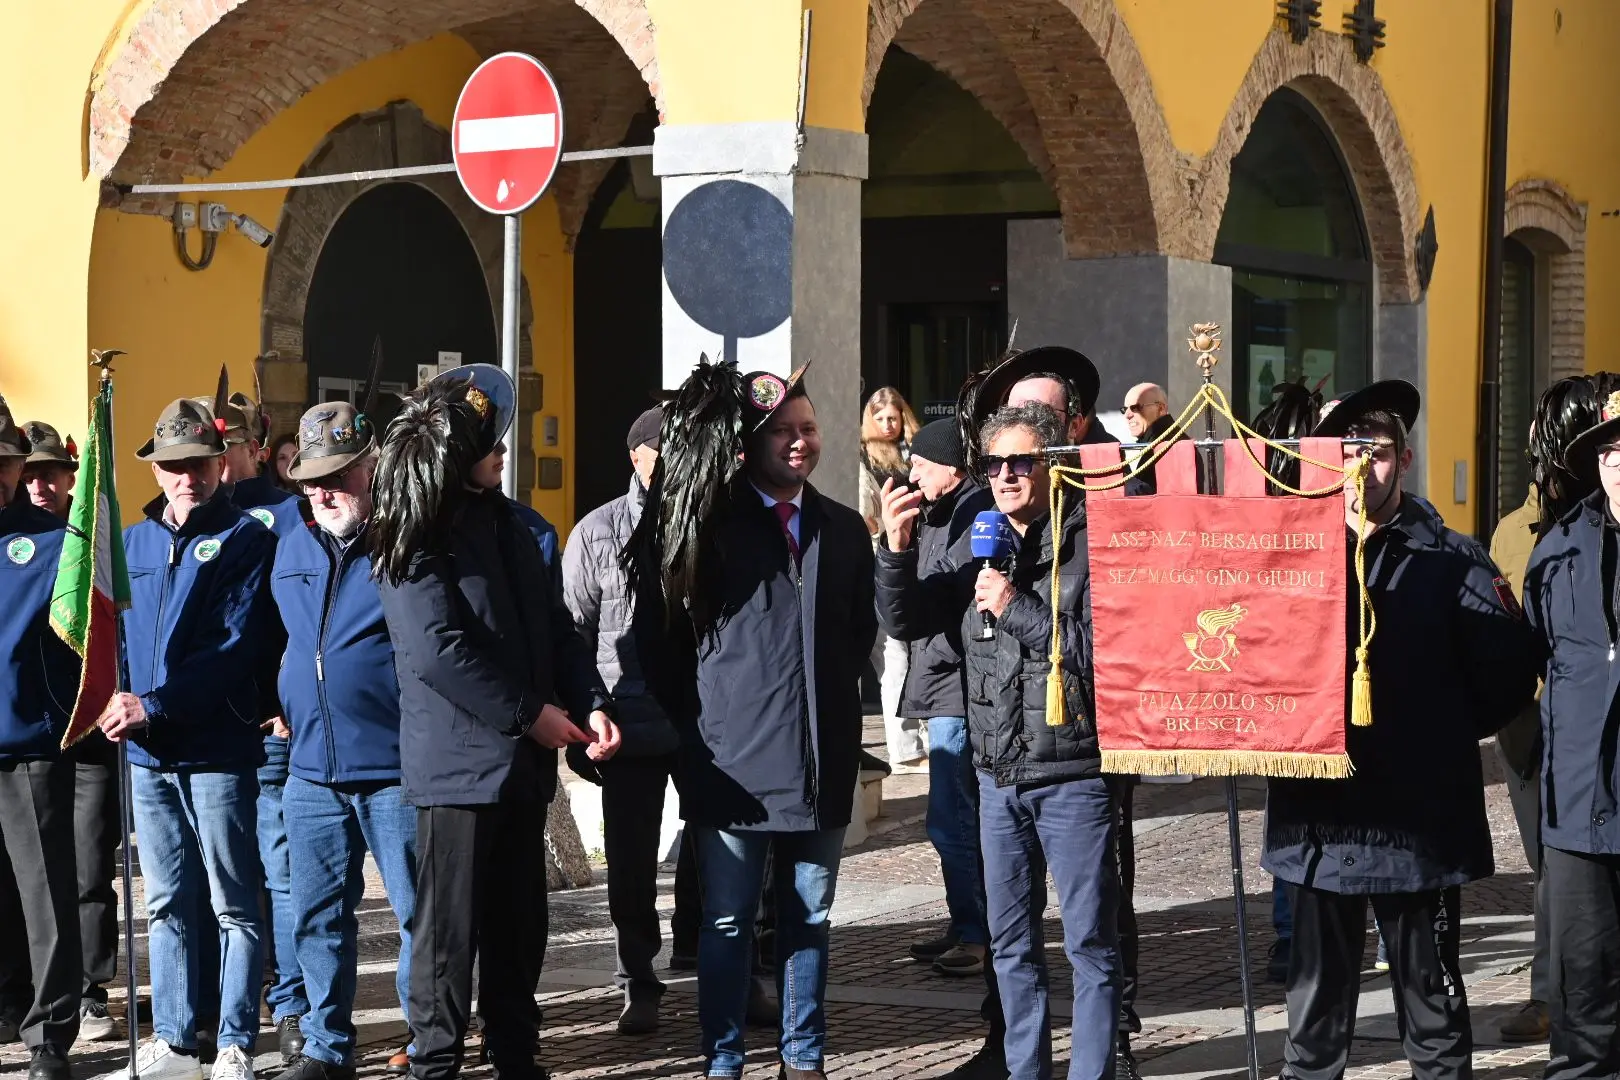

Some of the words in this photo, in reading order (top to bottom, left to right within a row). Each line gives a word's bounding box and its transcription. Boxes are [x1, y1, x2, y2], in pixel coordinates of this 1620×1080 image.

[1200, 532, 1325, 550] BERSAGLIERI
[1206, 569, 1250, 586] GINO
[1257, 570, 1325, 587] GIUDICI
[1137, 692, 1255, 712] PALAZZOLO
[1264, 694, 1296, 714] S/O
[1166, 717, 1258, 733] BRESCIA
